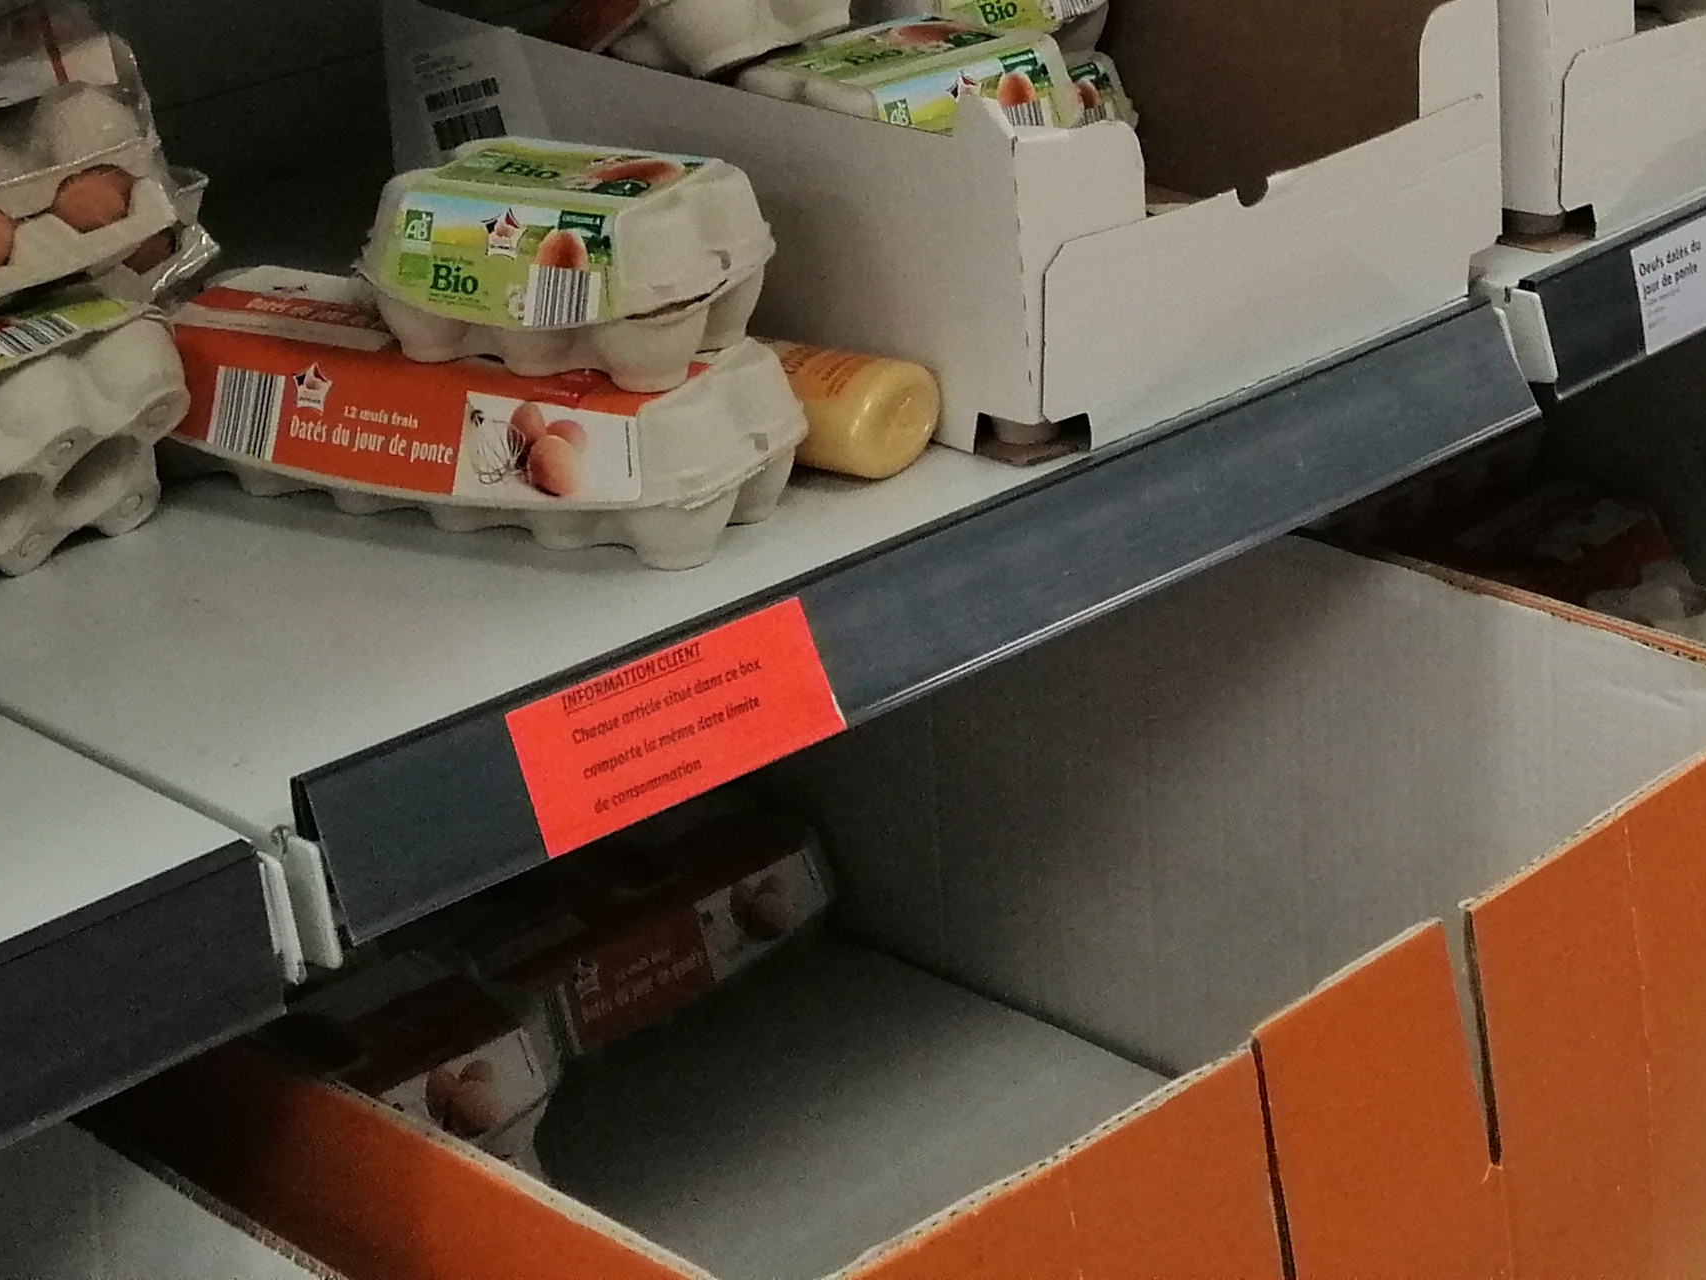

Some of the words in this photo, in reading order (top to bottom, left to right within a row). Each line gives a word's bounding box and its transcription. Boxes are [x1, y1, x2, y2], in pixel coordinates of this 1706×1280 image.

[980, 0, 1017, 25] Bio
[405, 218, 427, 240] AB
[430, 264, 479, 295] Bio
[1639, 255, 1665, 277] Oeufs
[1661, 272, 1673, 288] de
[391, 412, 419, 429] frais
[289, 415, 327, 443] Datés
[332, 423, 349, 446] du
[352, 427, 385, 453] jour
[389, 434, 406, 457] de
[410, 441, 454, 465] ponte
[561, 658, 655, 712] INFORMATION
[658, 641, 702, 673] CLIENT
[572, 712, 620, 747] Chaque
[622, 696, 662, 726] article
[664, 683, 693, 710] situé
[695, 673, 723, 698] dans
[725, 668, 738, 683] ce
[739, 658, 762, 678] box
[583, 746, 643, 784] comporte
[644, 738, 656, 756] la
[658, 721, 695, 751] même
[696, 711, 724, 734] date
[725, 694, 760, 722] limite
[593, 795, 610, 815] de
[611, 756, 703, 807] consommation
